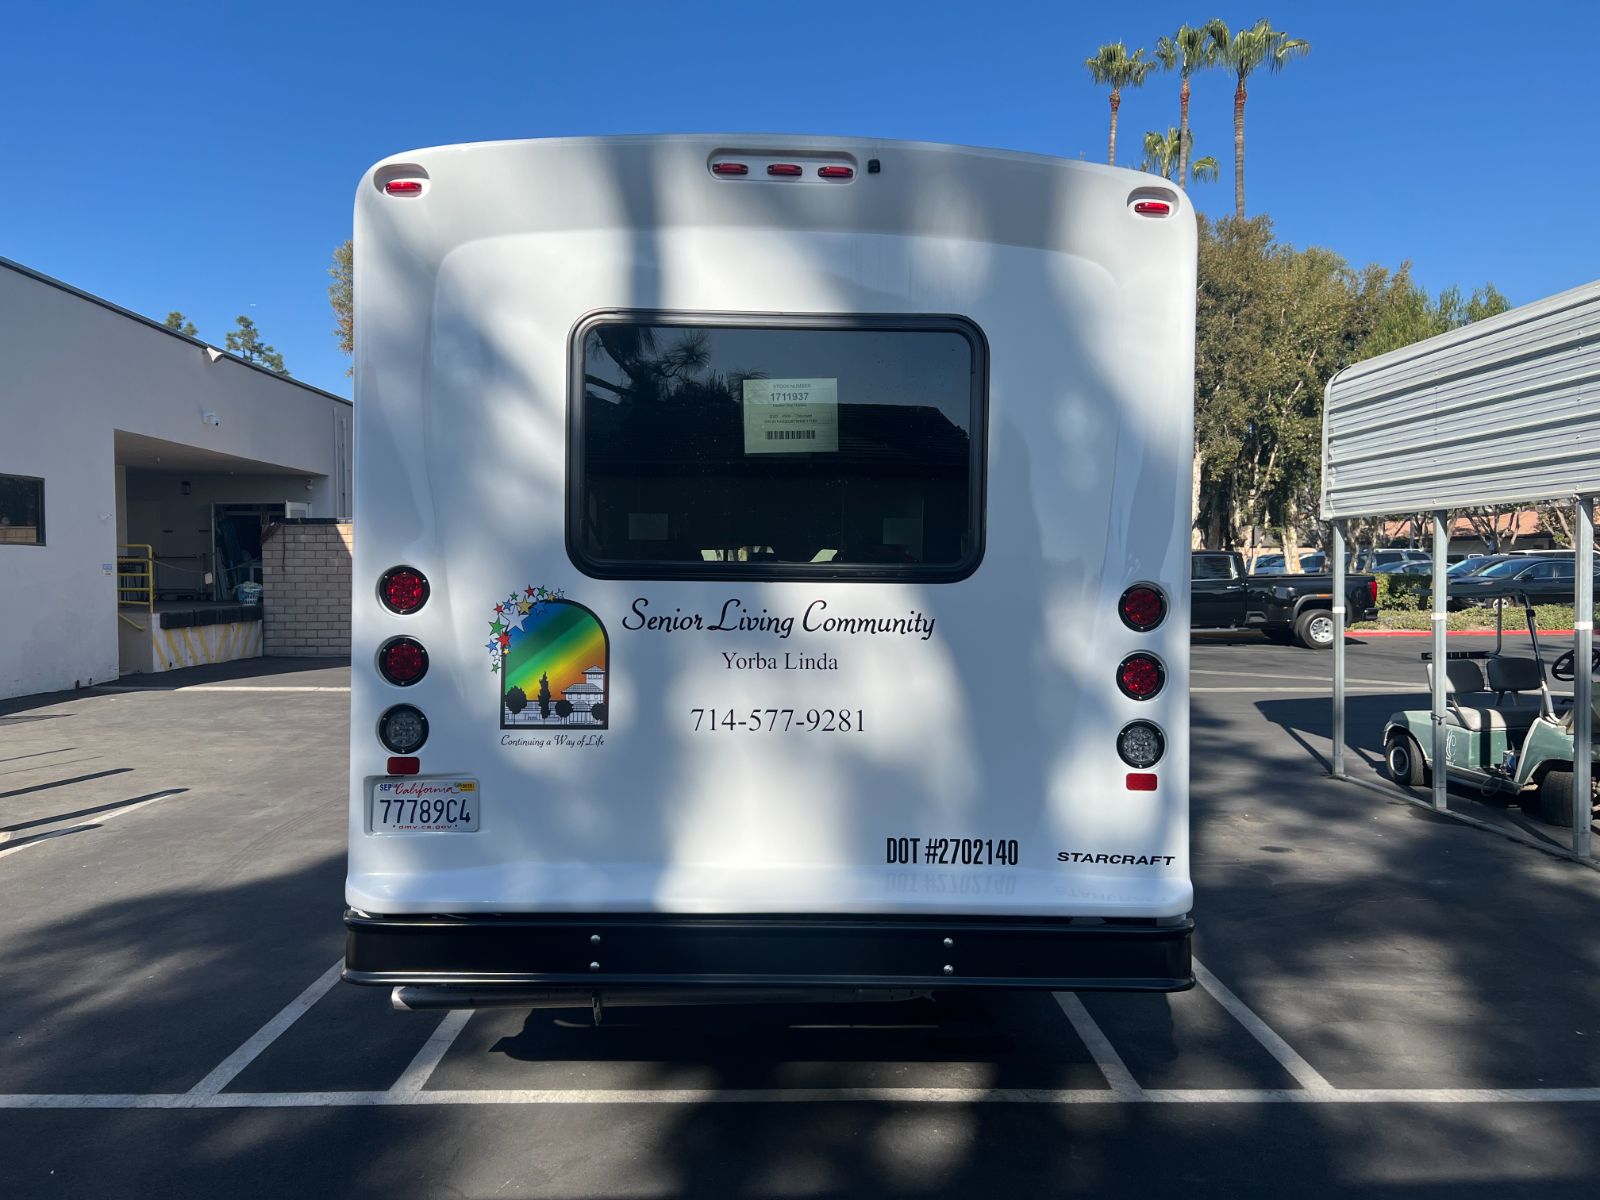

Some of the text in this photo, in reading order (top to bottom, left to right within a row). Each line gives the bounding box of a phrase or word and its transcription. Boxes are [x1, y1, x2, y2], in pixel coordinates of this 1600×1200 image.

[771, 392, 809, 401] 1711937
[622, 598, 936, 641] Senior Living Community
[722, 652, 838, 670] Yorba Linda
[691, 708, 865, 732] 714-577-9281
[501, 734, 544, 748] Continuing
[554, 735, 575, 748] Way
[576, 735, 587, 748] of
[585, 735, 605, 748] Life
[379, 783, 393, 792] SEP
[395, 782, 460, 798] California
[379, 799, 471, 824] 77789C4
[886, 837, 1019, 865] DOT #2702140
[1056, 851, 1176, 866] STARCRAFT
